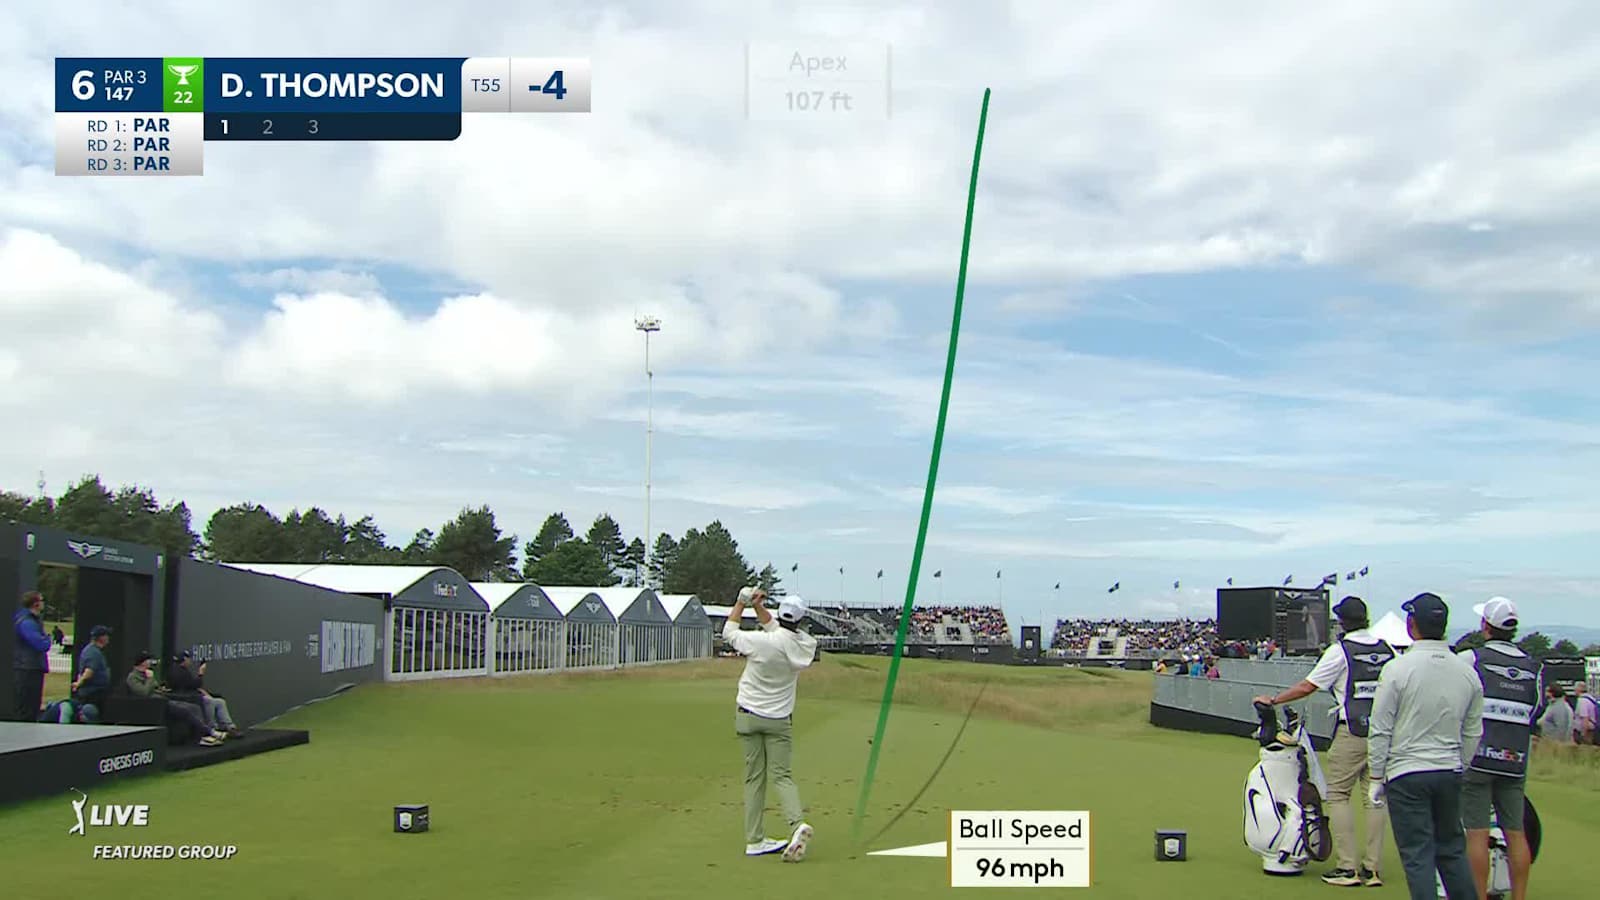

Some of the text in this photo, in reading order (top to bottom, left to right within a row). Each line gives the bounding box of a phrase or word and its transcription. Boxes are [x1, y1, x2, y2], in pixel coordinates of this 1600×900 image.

[99, 749, 153, 774] GENESIS GV60
[1486, 746, 1518, 762] FedEx
